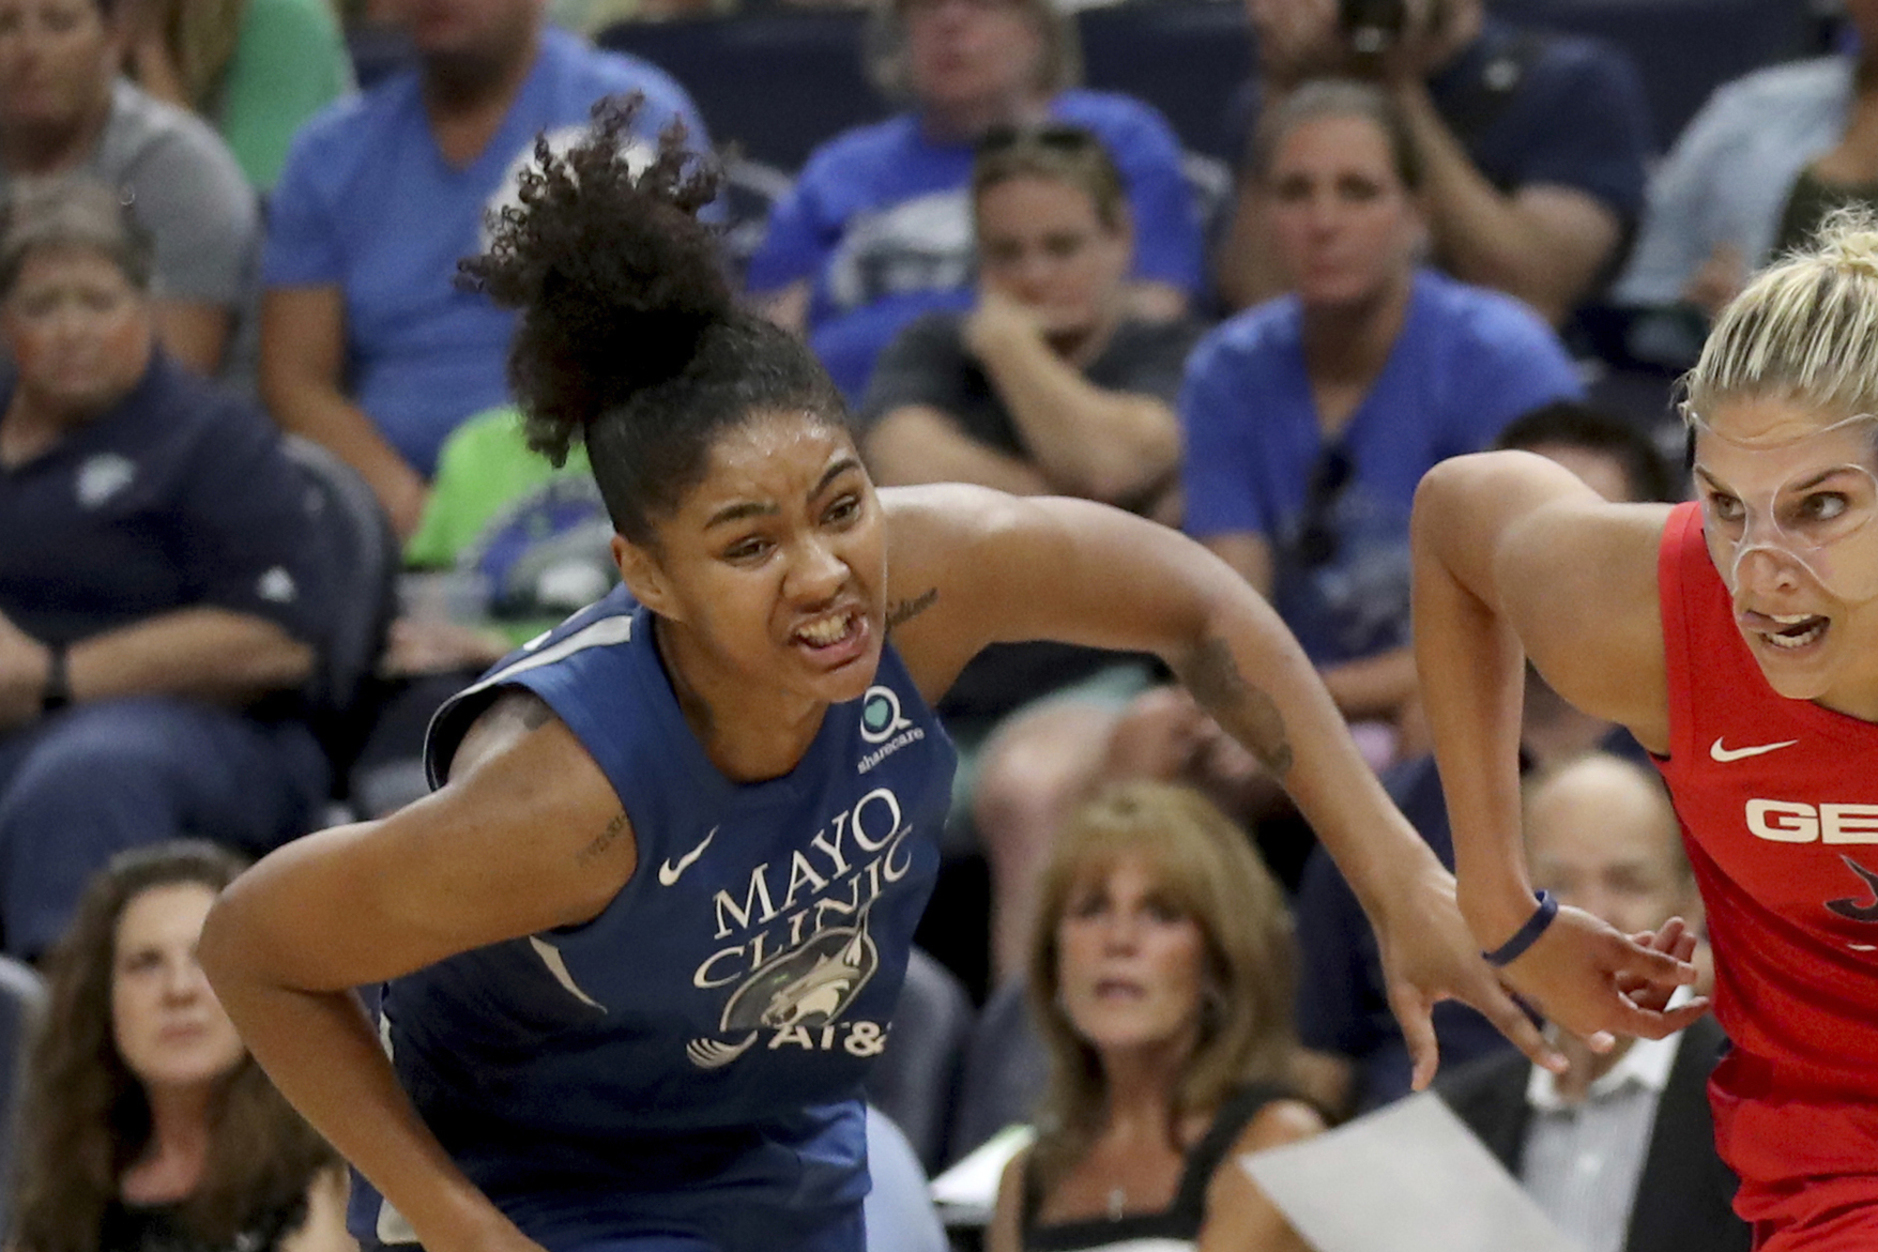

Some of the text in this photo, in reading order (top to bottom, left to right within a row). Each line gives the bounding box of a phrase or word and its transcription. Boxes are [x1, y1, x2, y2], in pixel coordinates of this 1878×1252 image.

[857, 727, 925, 775] sharecare
[693, 824, 914, 988] CLINIC
[713, 788, 902, 940] MAYO
[767, 1021, 893, 1057] AT&
